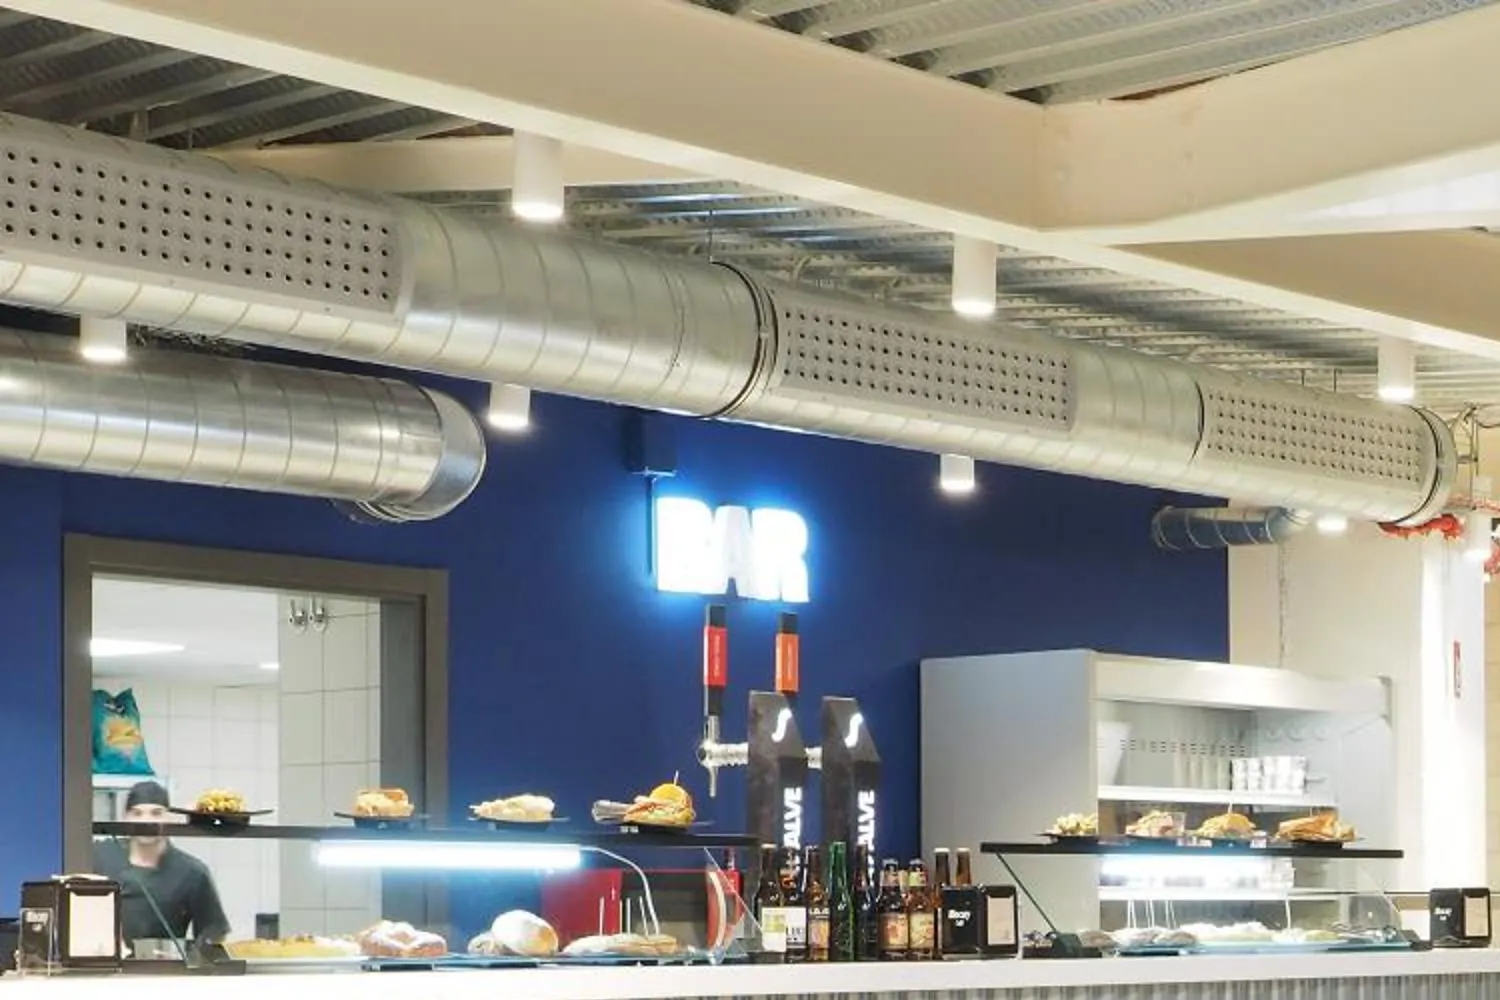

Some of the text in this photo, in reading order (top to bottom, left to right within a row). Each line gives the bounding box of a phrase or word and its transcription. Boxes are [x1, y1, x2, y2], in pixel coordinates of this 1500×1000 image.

[655, 496, 810, 603] BAR
[782, 787, 802, 868] ALVE
[857, 789, 876, 867] ALVE
